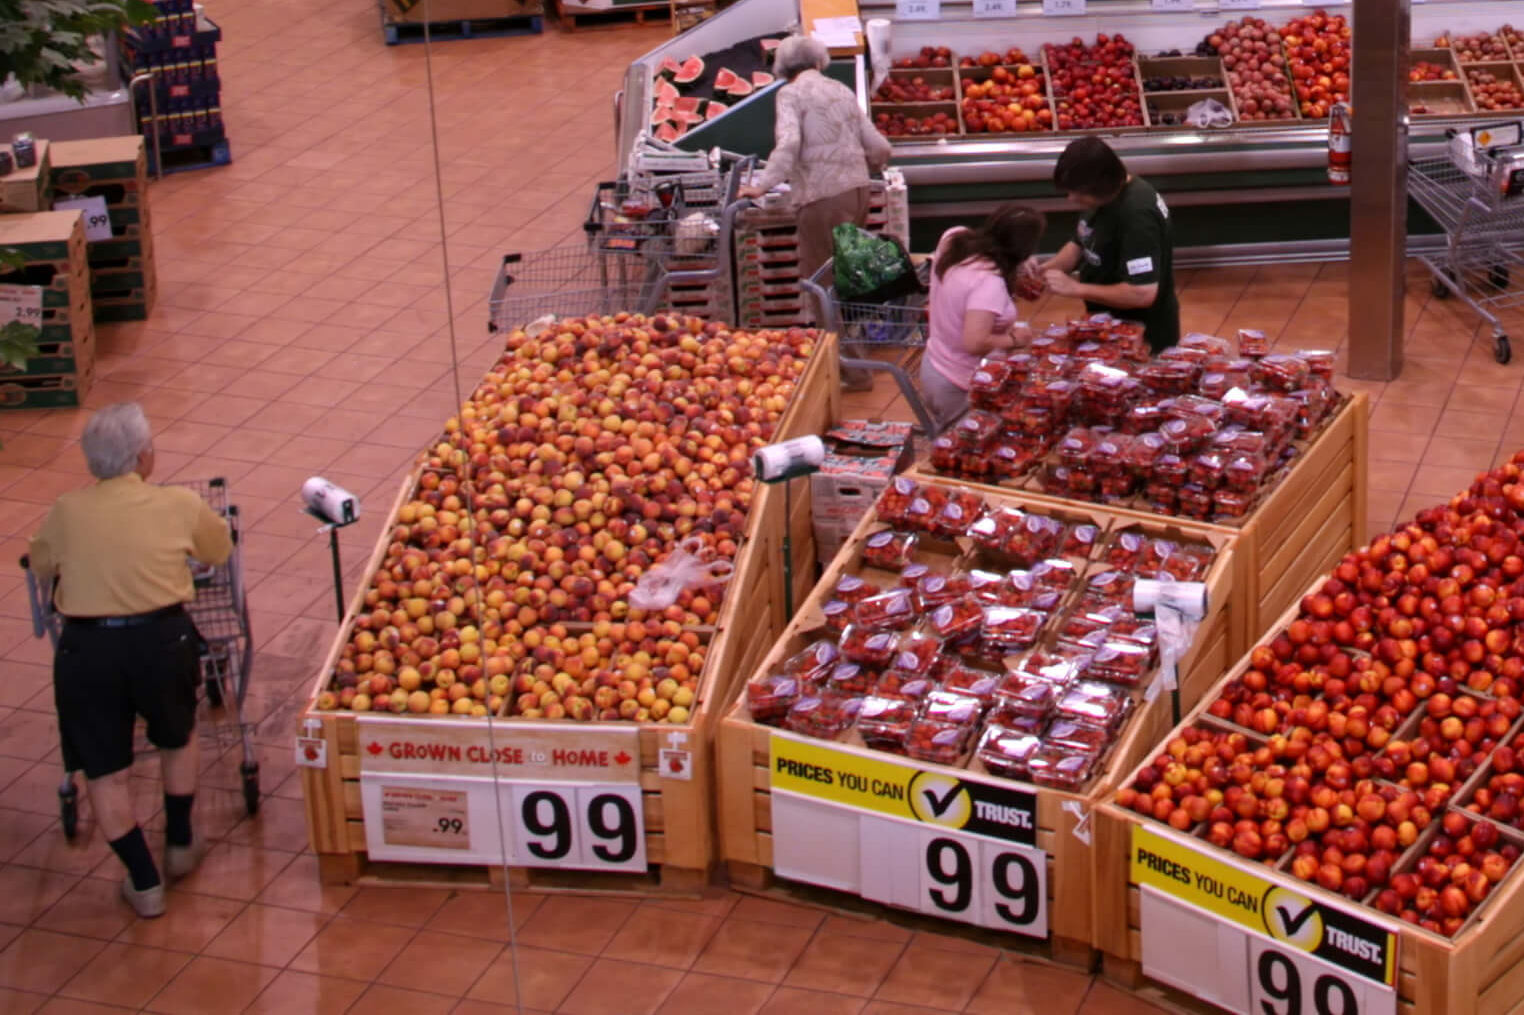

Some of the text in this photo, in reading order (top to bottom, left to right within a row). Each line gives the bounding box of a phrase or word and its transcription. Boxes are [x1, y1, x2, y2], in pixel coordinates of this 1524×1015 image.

[15, 306, 41, 318] 2.99
[388, 741, 609, 767] GROWN CLOSE to HOME
[432, 816, 463, 834] .99
[521, 790, 637, 863] 99
[776, 757, 1033, 830] PRICES YOU CAN TRUST.
[926, 837, 1039, 926] 99
[1137, 848, 1383, 966] PRICES YOU CAN TRUST.
